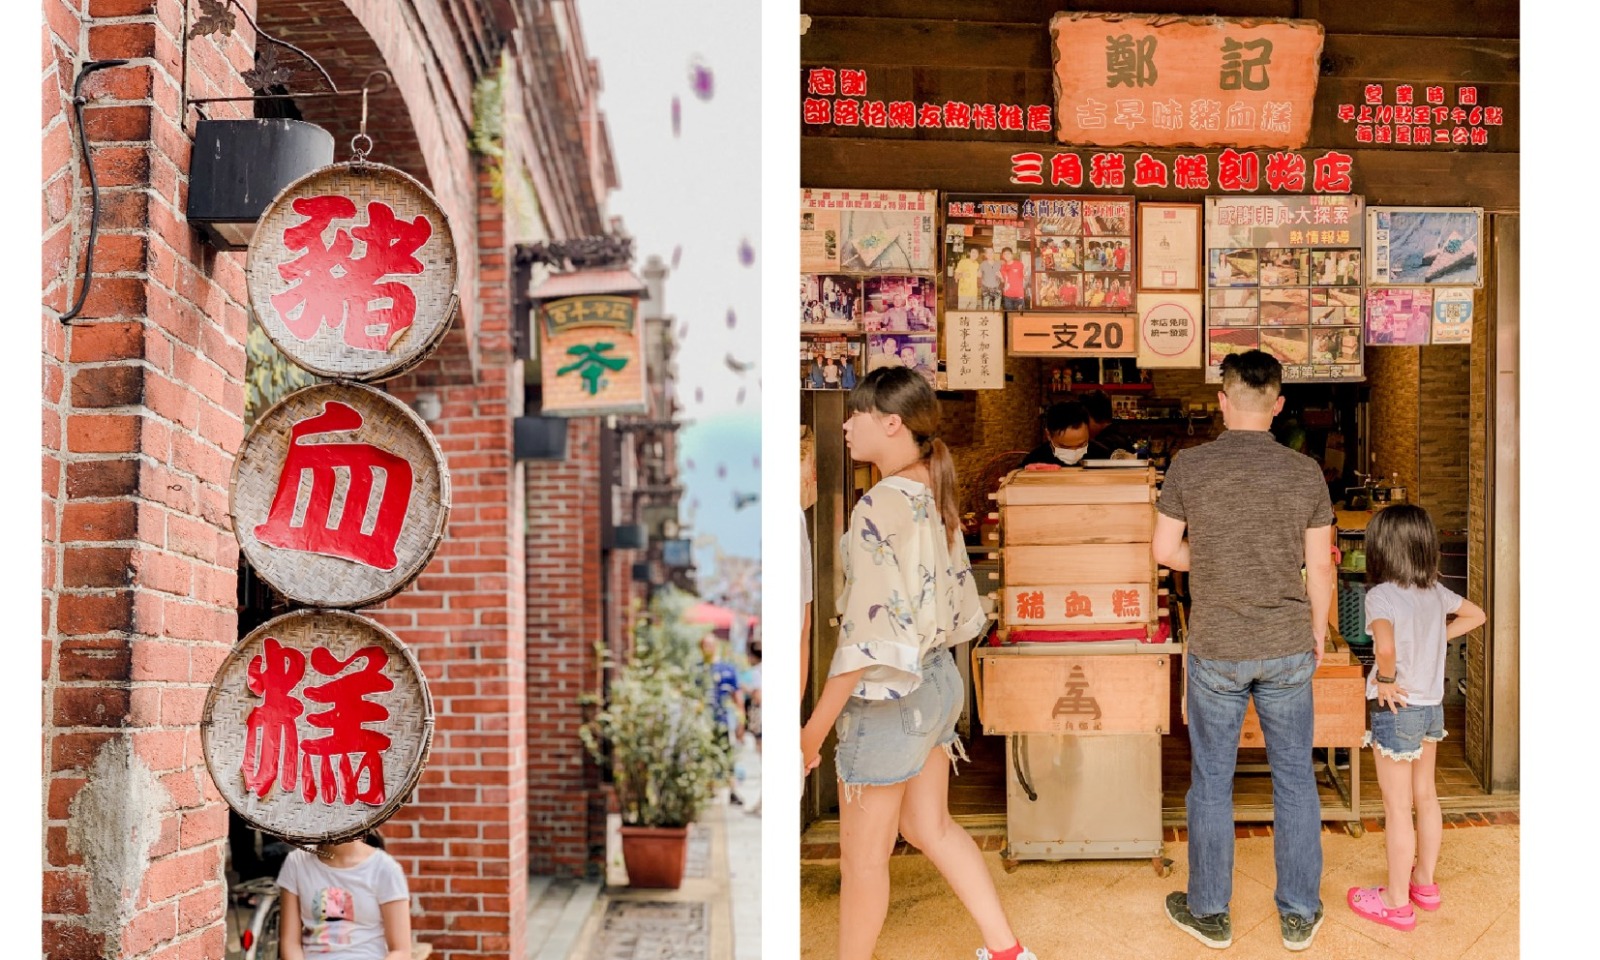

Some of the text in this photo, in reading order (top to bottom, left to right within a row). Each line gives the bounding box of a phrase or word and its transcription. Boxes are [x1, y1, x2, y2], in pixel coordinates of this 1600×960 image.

[1105, 34, 1274, 91] 鄭記
[808, 67, 867, 96] 感謝
[1364, 84, 1478, 106] 營業時間
[803, 98, 1053, 132] 部落格網友熱情推薦
[1076, 98, 1292, 133] 古早味豬血糕
[1337, 104, 1503, 126] 早上10點至下午6點
[1356, 125, 1488, 145] 每逢星期二公休
[1010, 149, 1354, 193] 三角豬血糕創始店
[1022, 199, 1080, 217] 食尚玩家
[1218, 206, 1350, 225] 感謝非凡大探索
[1289, 230, 1350, 245] 熱情報導
[1024, 322, 1124, 349] 一支20
[557, 342, 629, 395] 茶
[240, 195, 432, 806] 豬血糕
[1016, 589, 1141, 619] 豬血糕
